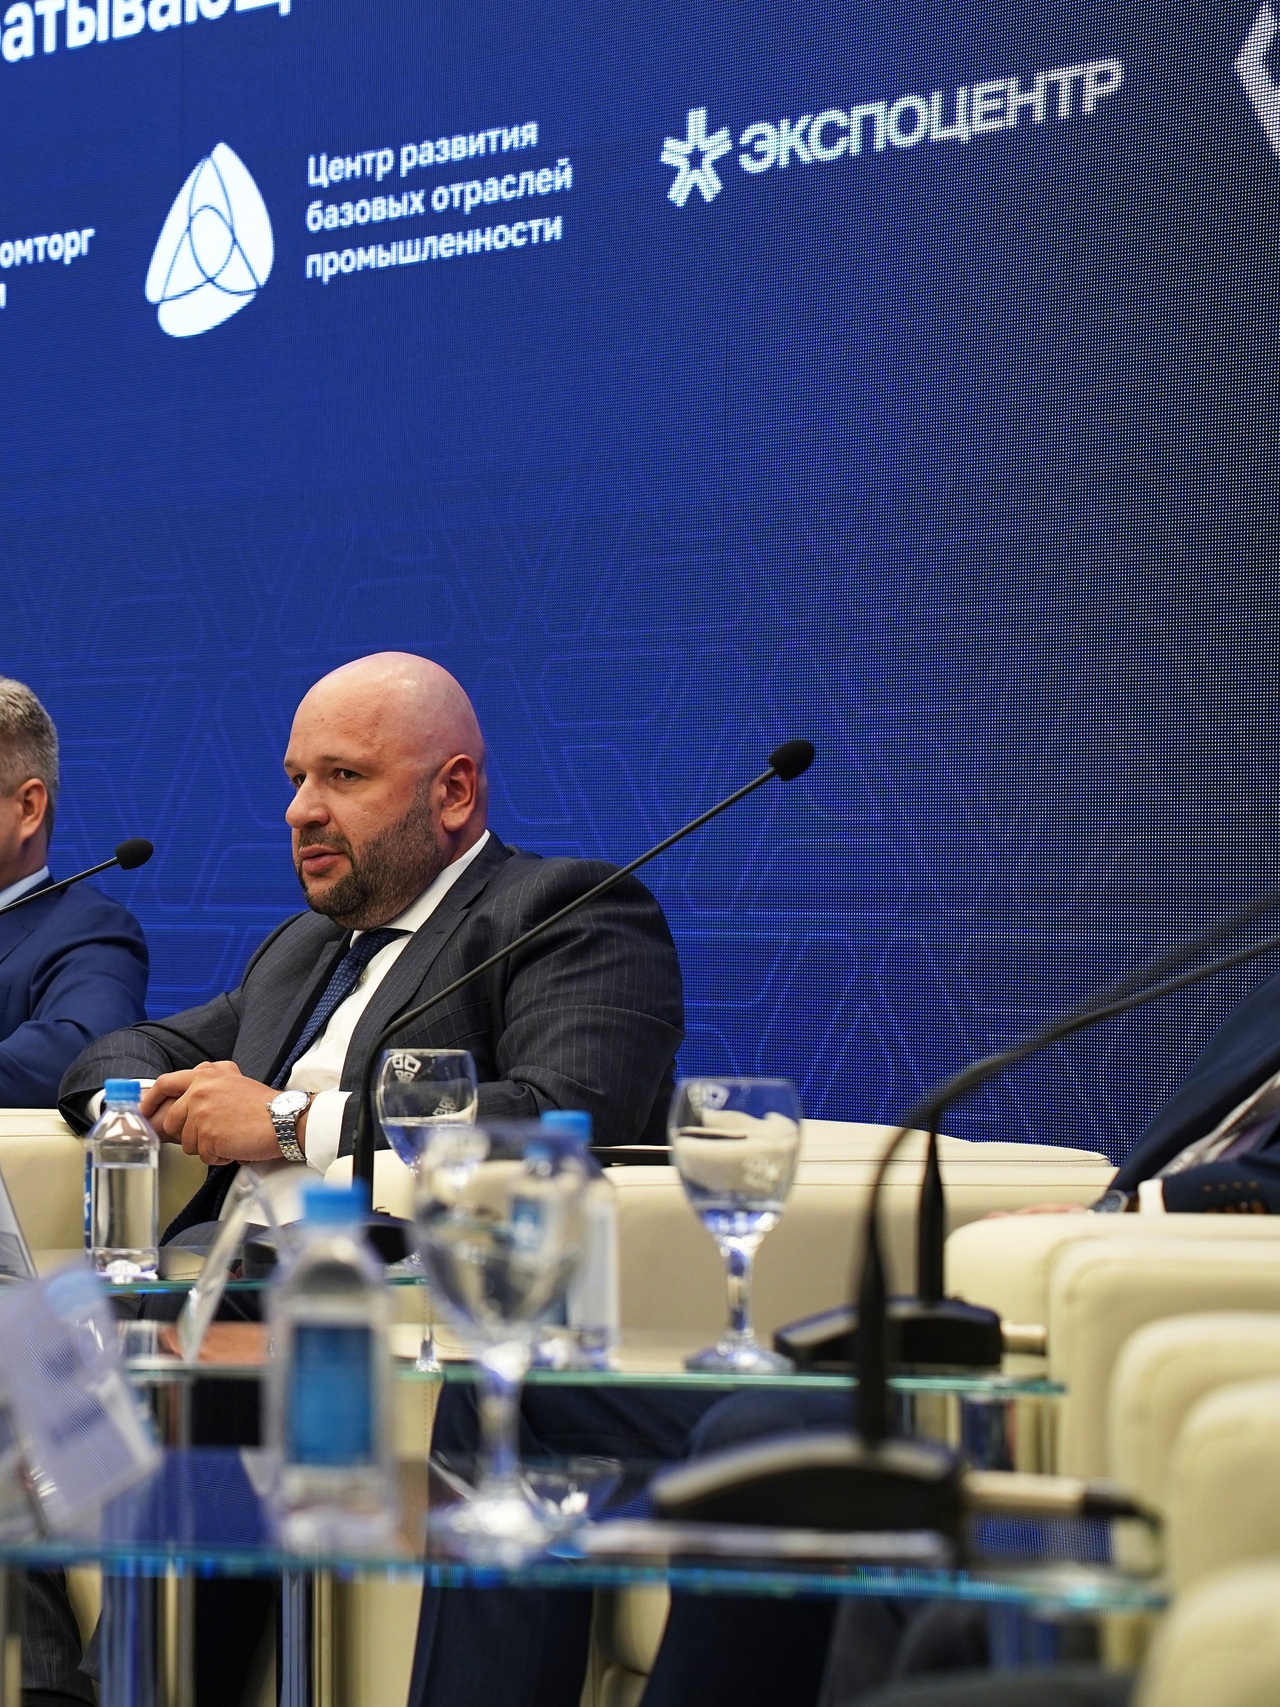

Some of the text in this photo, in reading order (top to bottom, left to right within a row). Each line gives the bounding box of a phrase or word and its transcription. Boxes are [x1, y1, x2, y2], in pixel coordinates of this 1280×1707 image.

[737, 57, 1123, 175] ЭКСПОЦЕНТР
[307, 120, 539, 189] Центр развития
[305, 157, 573, 234] базовых отраслей
[305, 215, 563, 285] промышленности
